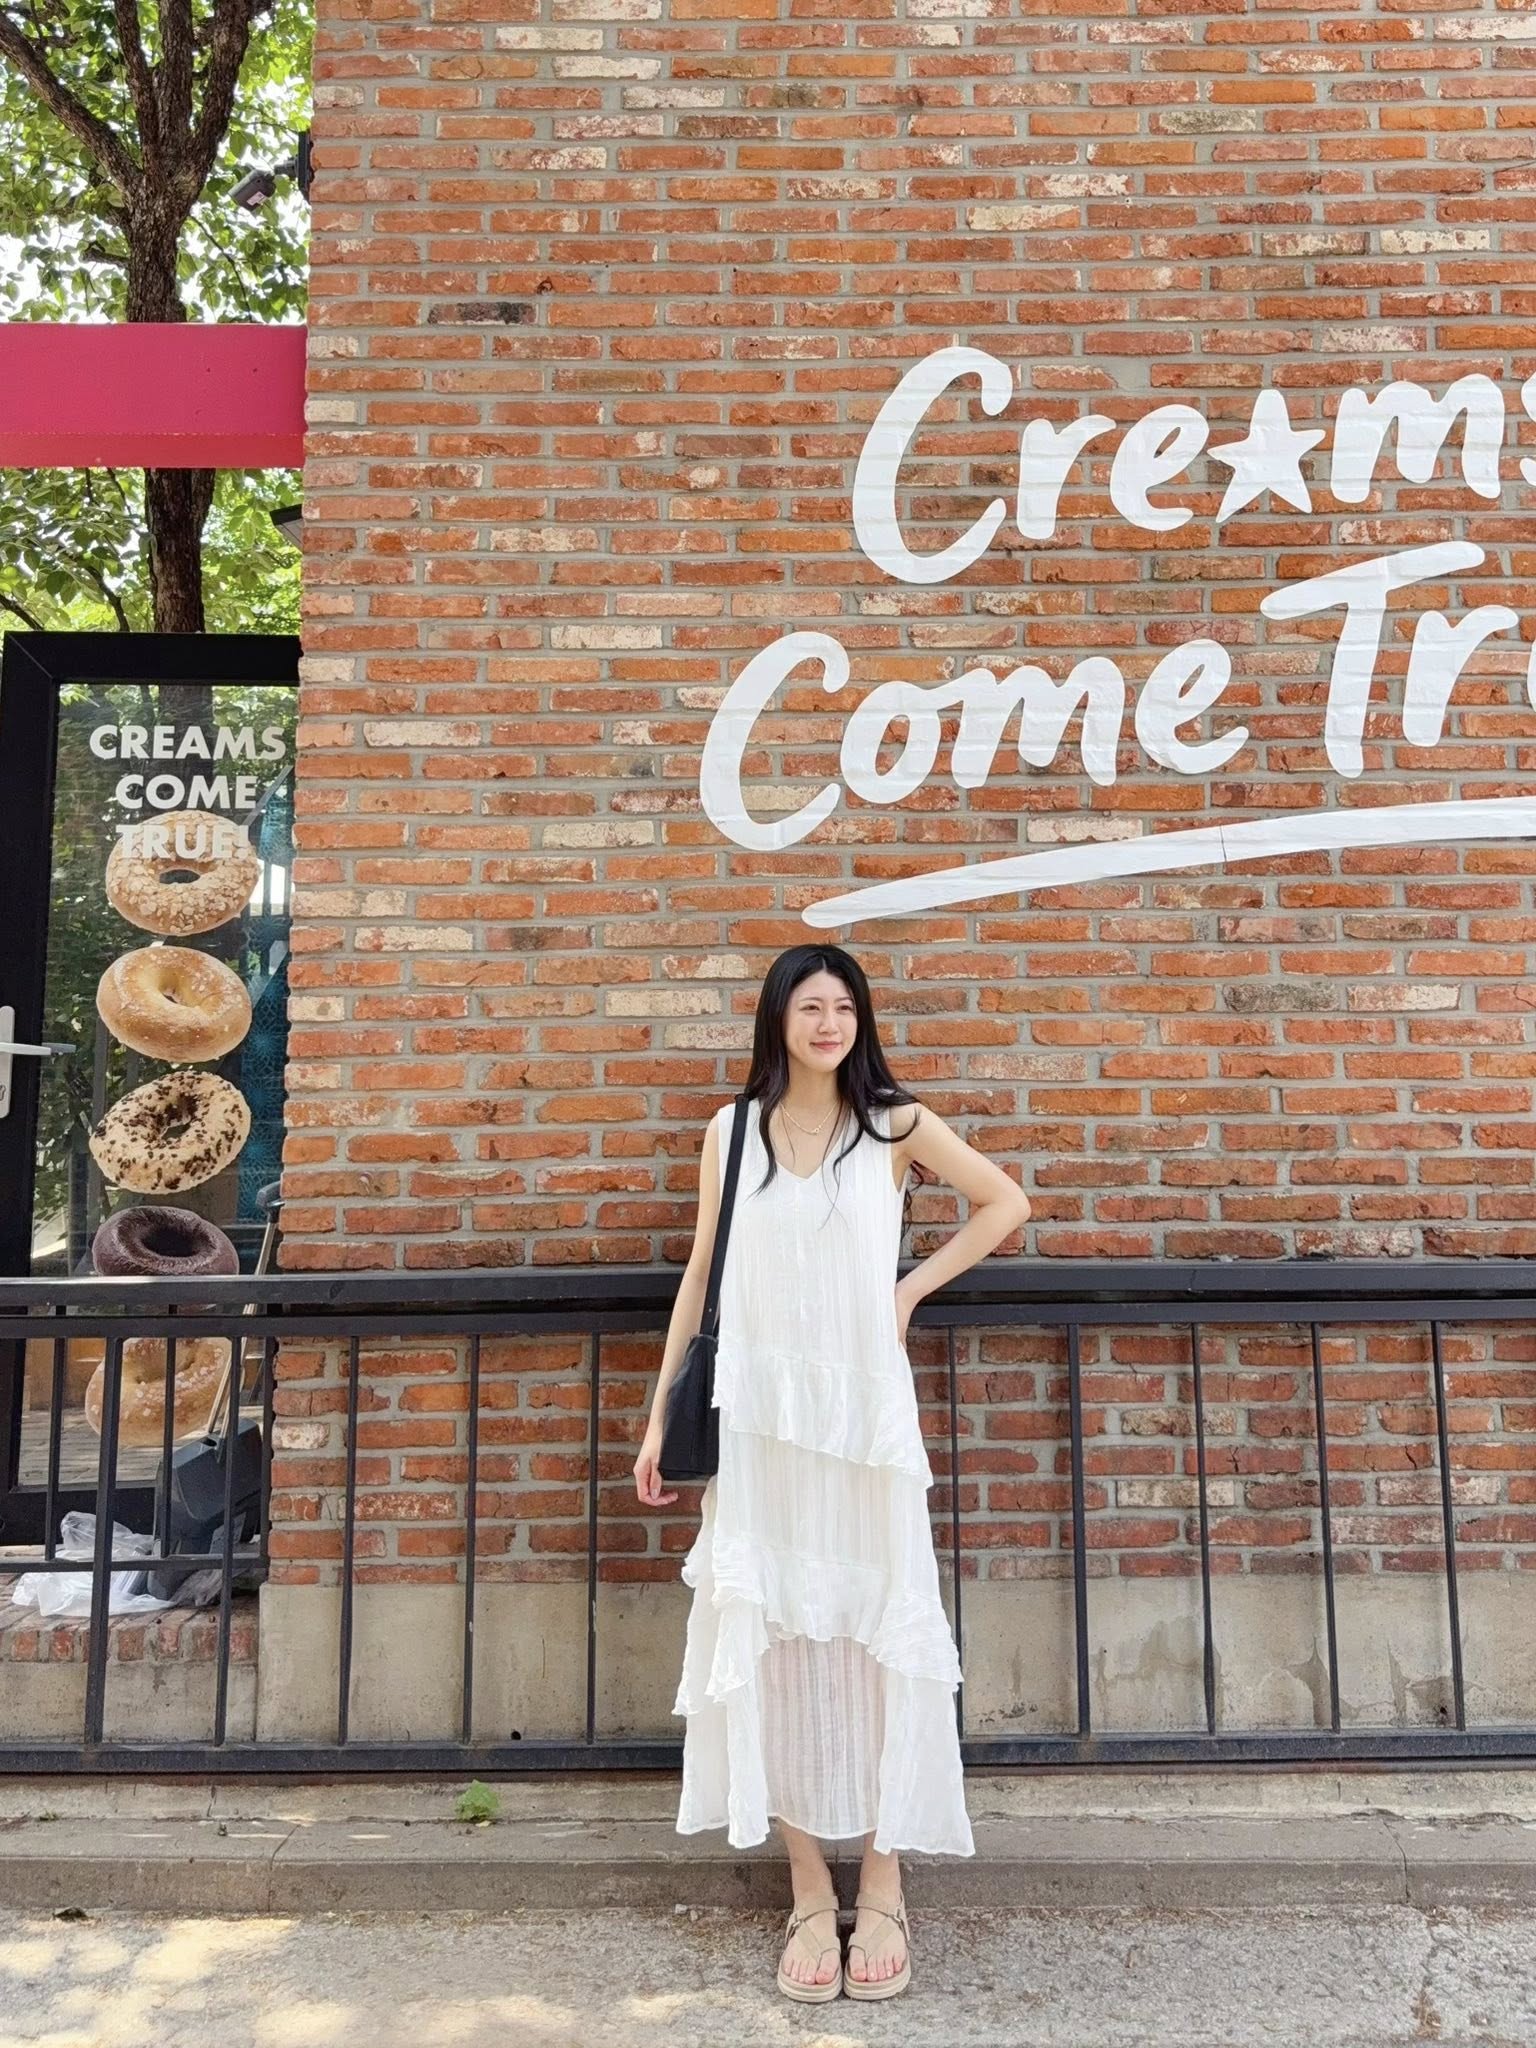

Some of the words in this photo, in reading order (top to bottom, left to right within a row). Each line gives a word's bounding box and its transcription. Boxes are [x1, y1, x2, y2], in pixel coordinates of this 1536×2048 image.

[699, 631, 1249, 851] Come
[1260, 541, 1536, 778] Tr
[89, 724, 286, 760] CREAMS
[115, 774, 257, 809] COME
[116, 824, 250, 859] TRUE!
